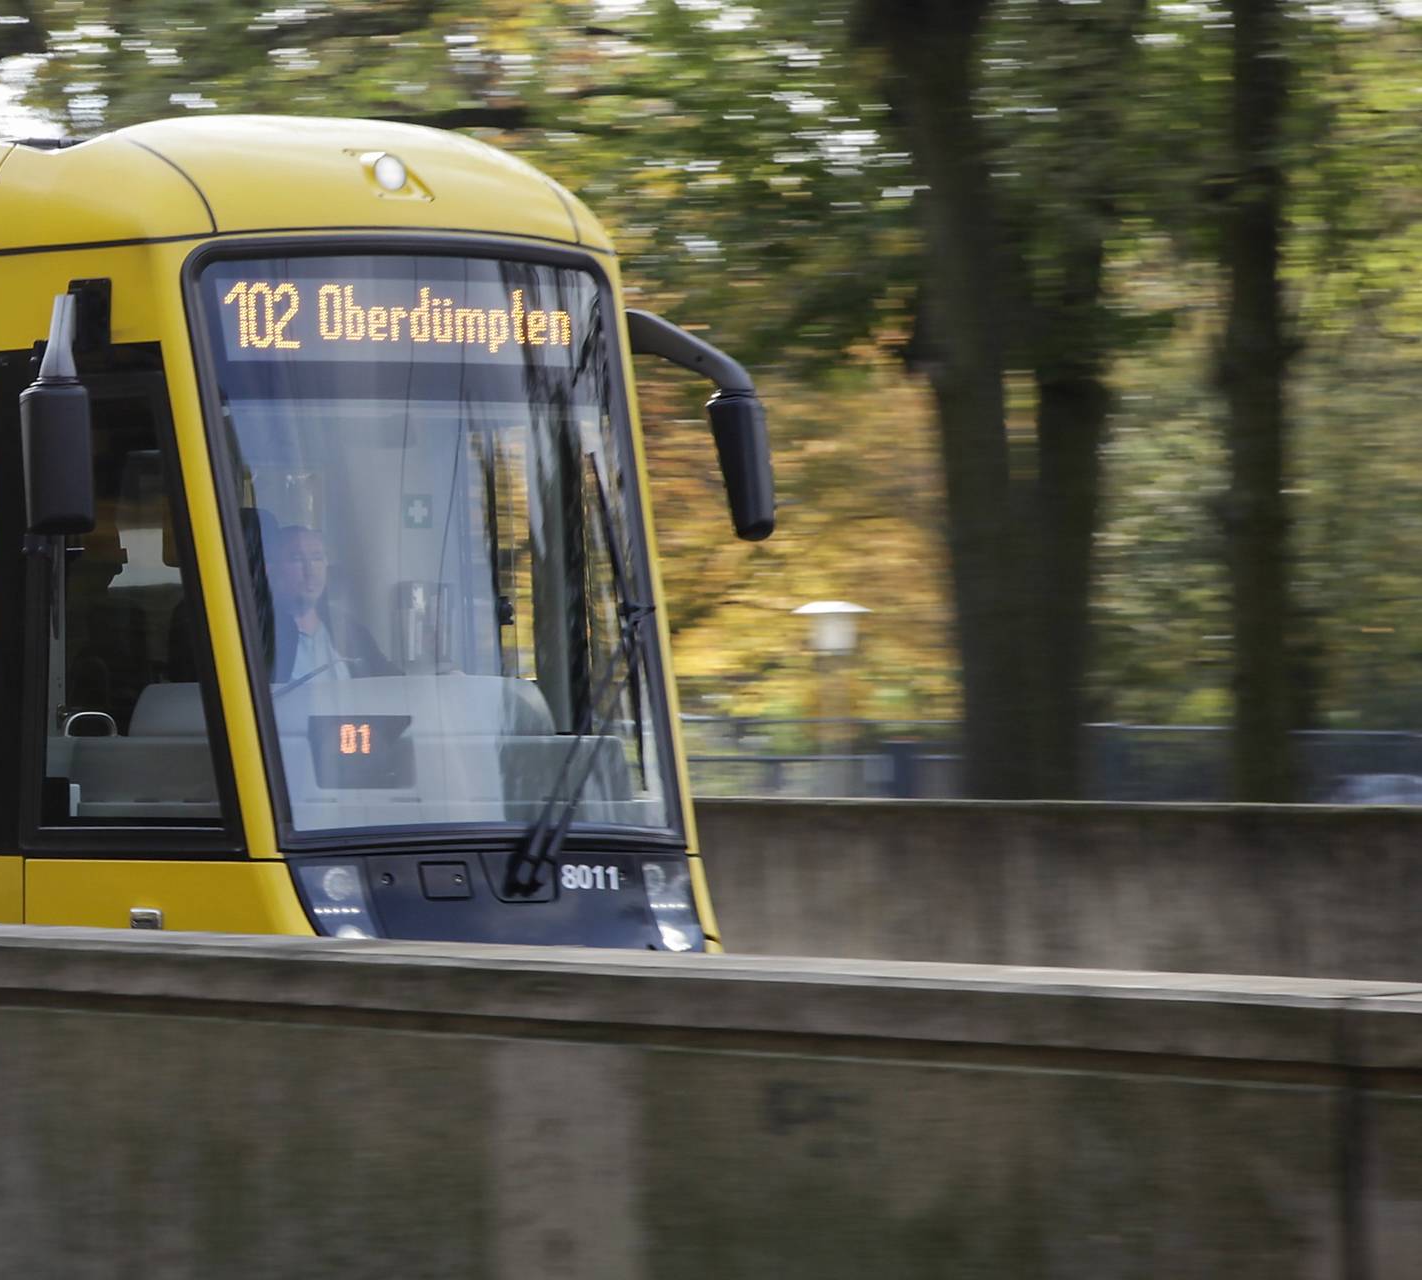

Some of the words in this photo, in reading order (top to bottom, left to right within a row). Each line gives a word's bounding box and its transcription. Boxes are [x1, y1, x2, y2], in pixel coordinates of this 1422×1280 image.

[223, 281, 301, 349] 102
[318, 284, 572, 354] Oberdümpten
[339, 723, 371, 754] 01
[561, 864, 619, 890] 8011
